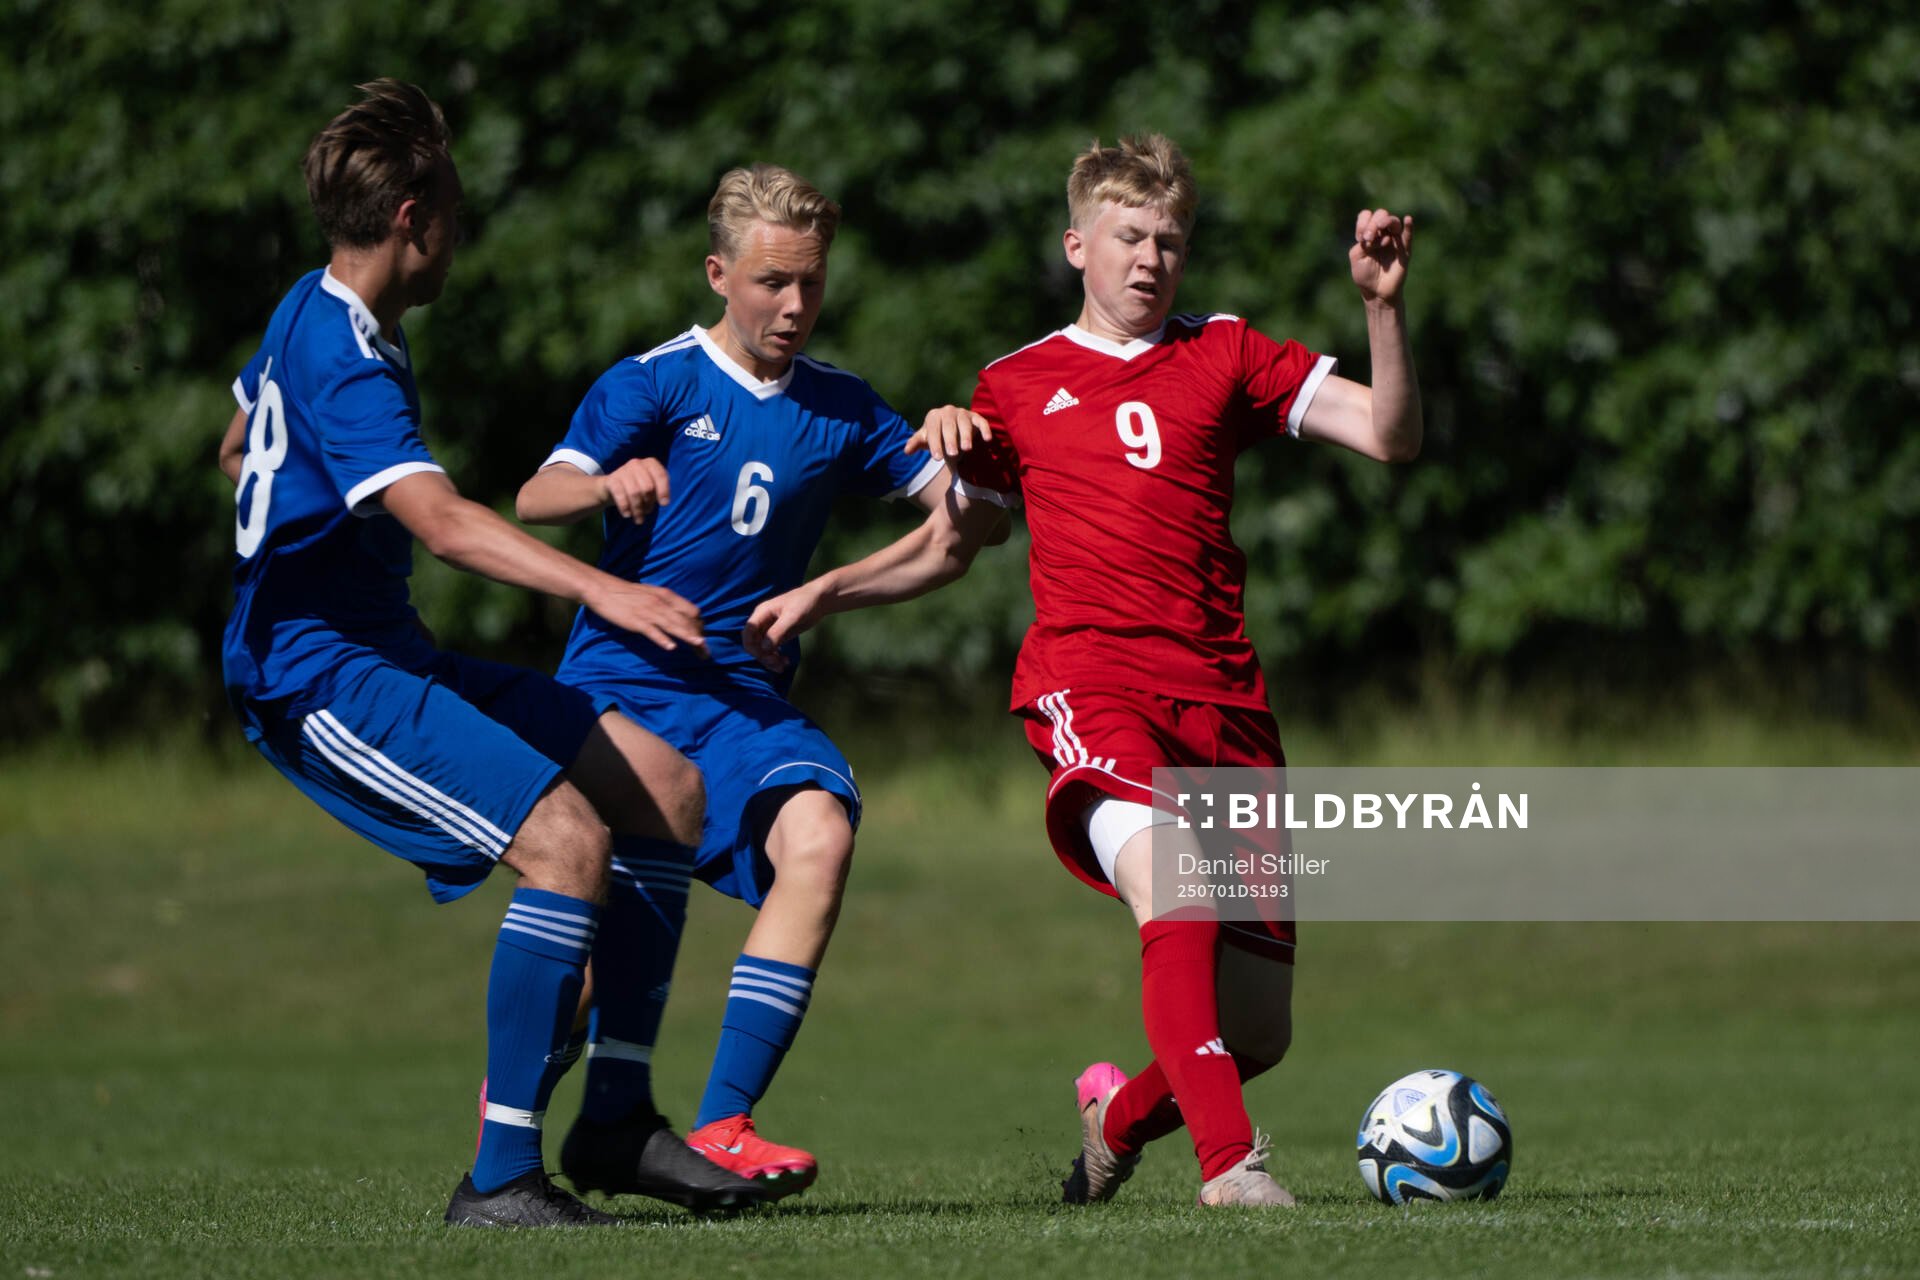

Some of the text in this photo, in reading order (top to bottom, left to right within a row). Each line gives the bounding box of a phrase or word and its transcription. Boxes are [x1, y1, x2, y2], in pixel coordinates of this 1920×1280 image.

[684, 426, 721, 441] adidas
[1042, 397, 1080, 416] adidas
[1115, 401, 1162, 469] 9
[234, 379, 289, 559] 8
[731, 461, 774, 536] 6
